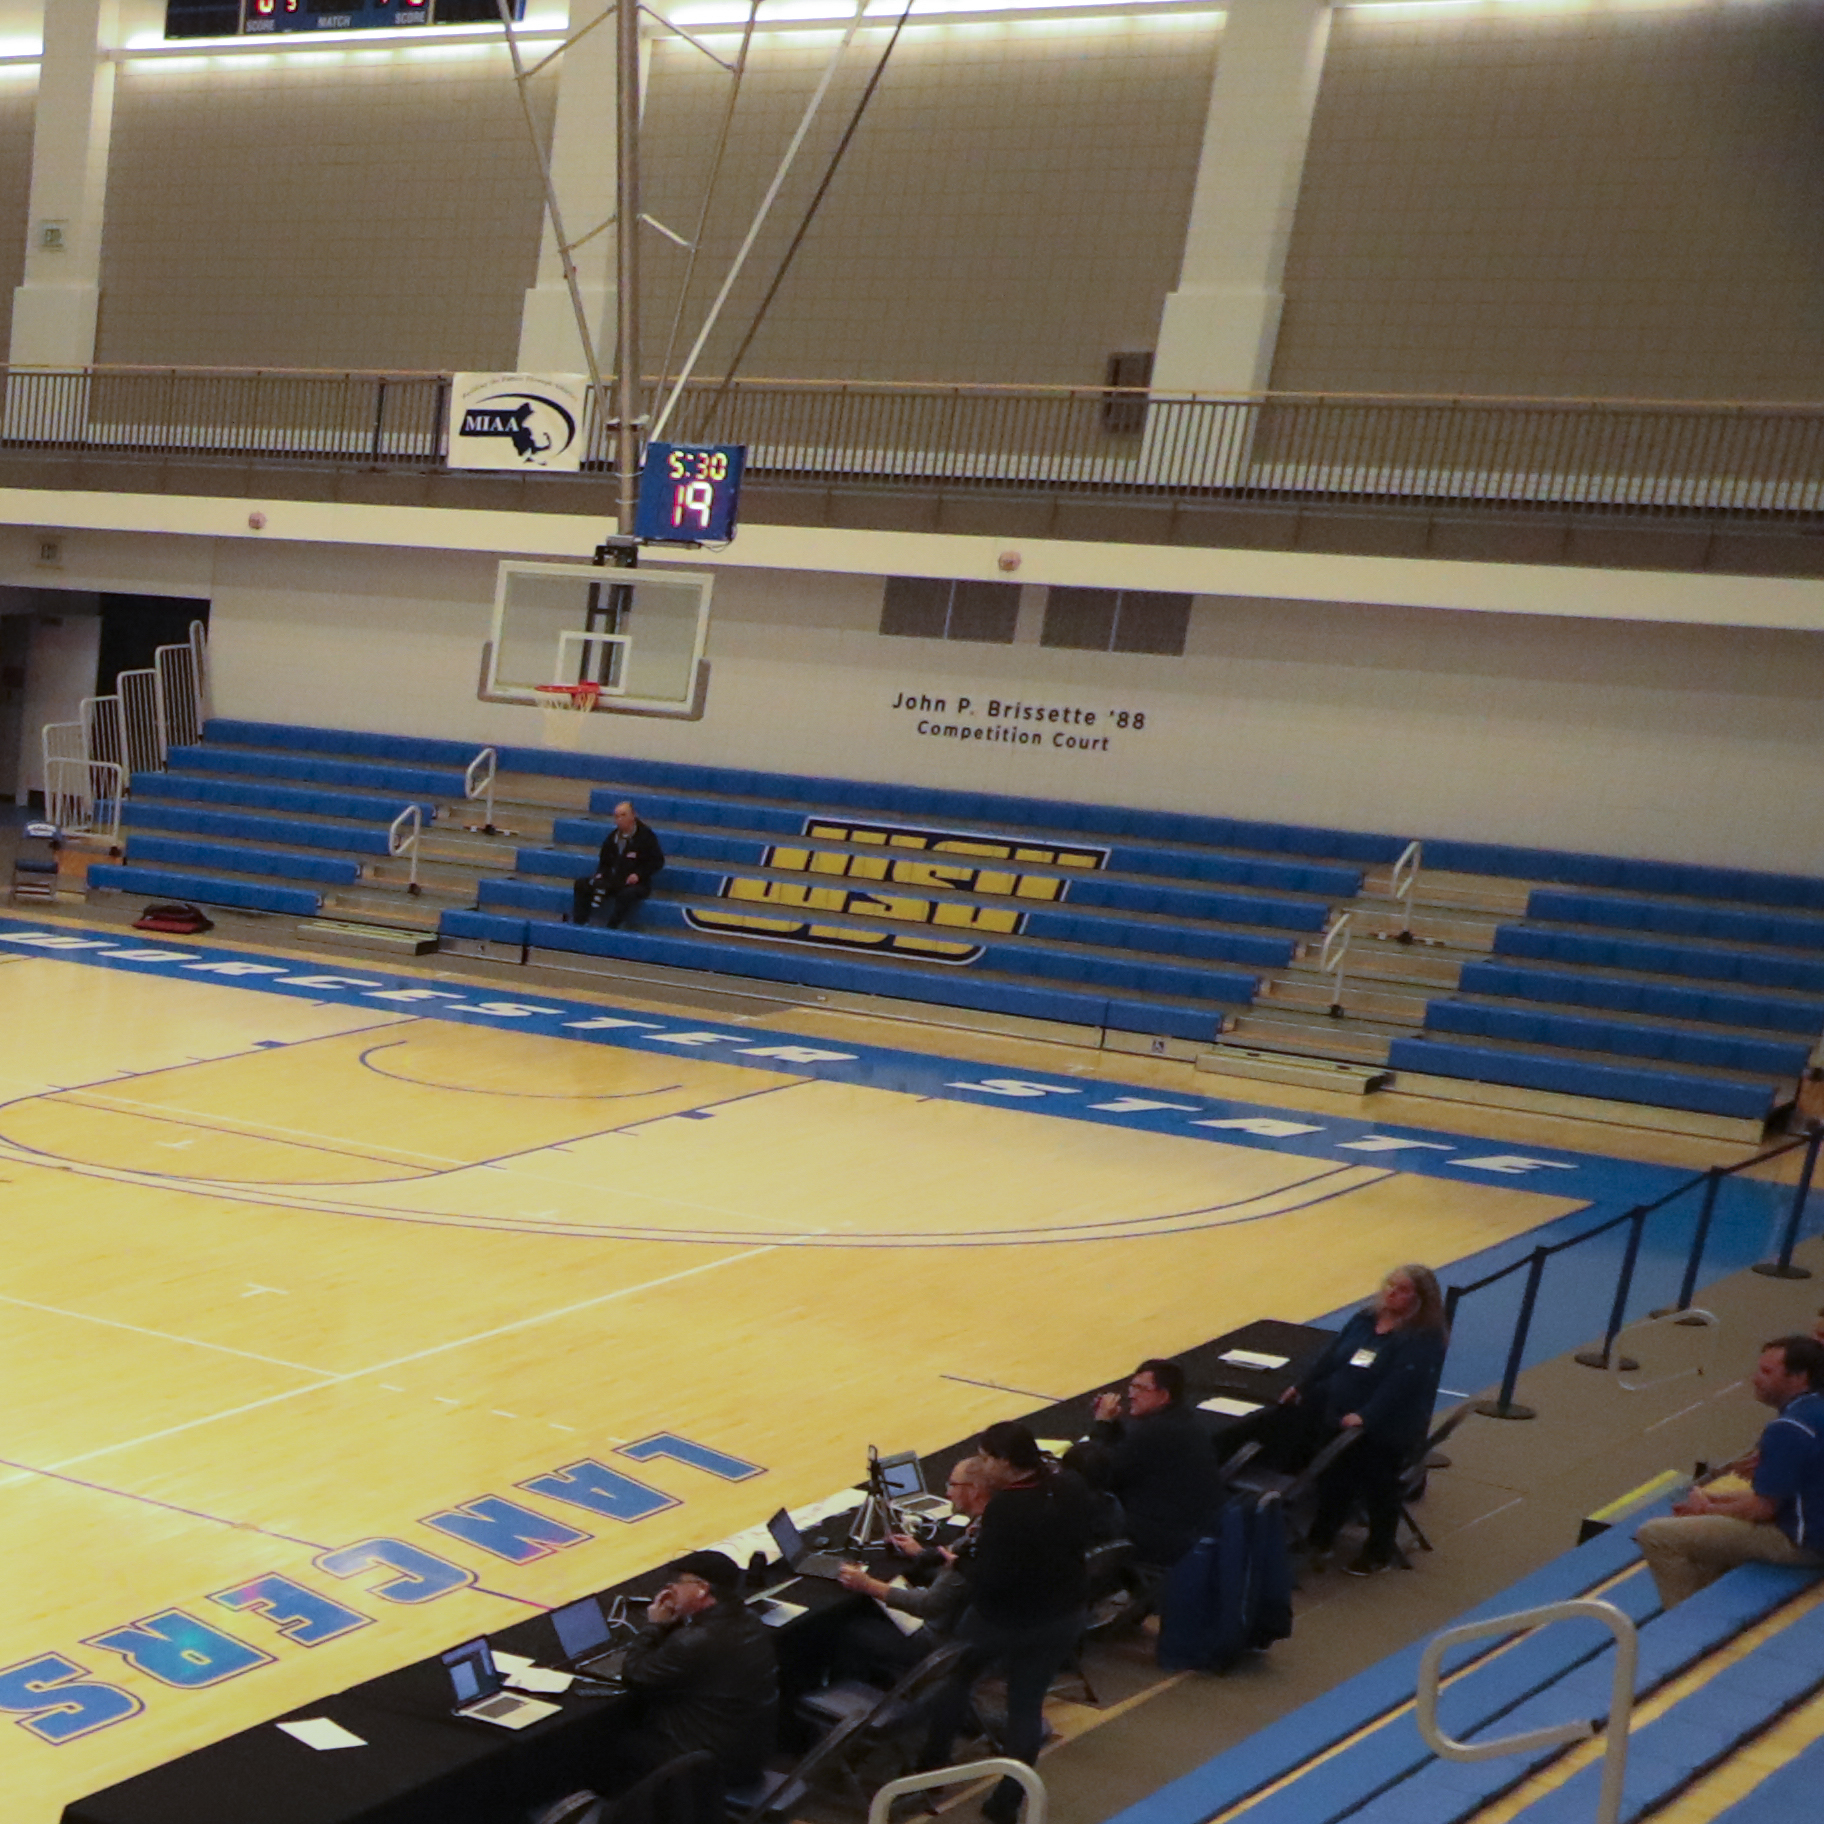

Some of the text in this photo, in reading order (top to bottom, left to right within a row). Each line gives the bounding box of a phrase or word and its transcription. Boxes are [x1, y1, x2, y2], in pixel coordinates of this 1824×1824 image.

[465, 415, 520, 432] MIAA
[668, 450, 729, 480] 5:30
[671, 481, 714, 528] 19
[892, 692, 1146, 730] John P. Brissette '88
[917, 720, 1110, 752] Competition Court
[943, 1077, 1580, 1174] STATE
